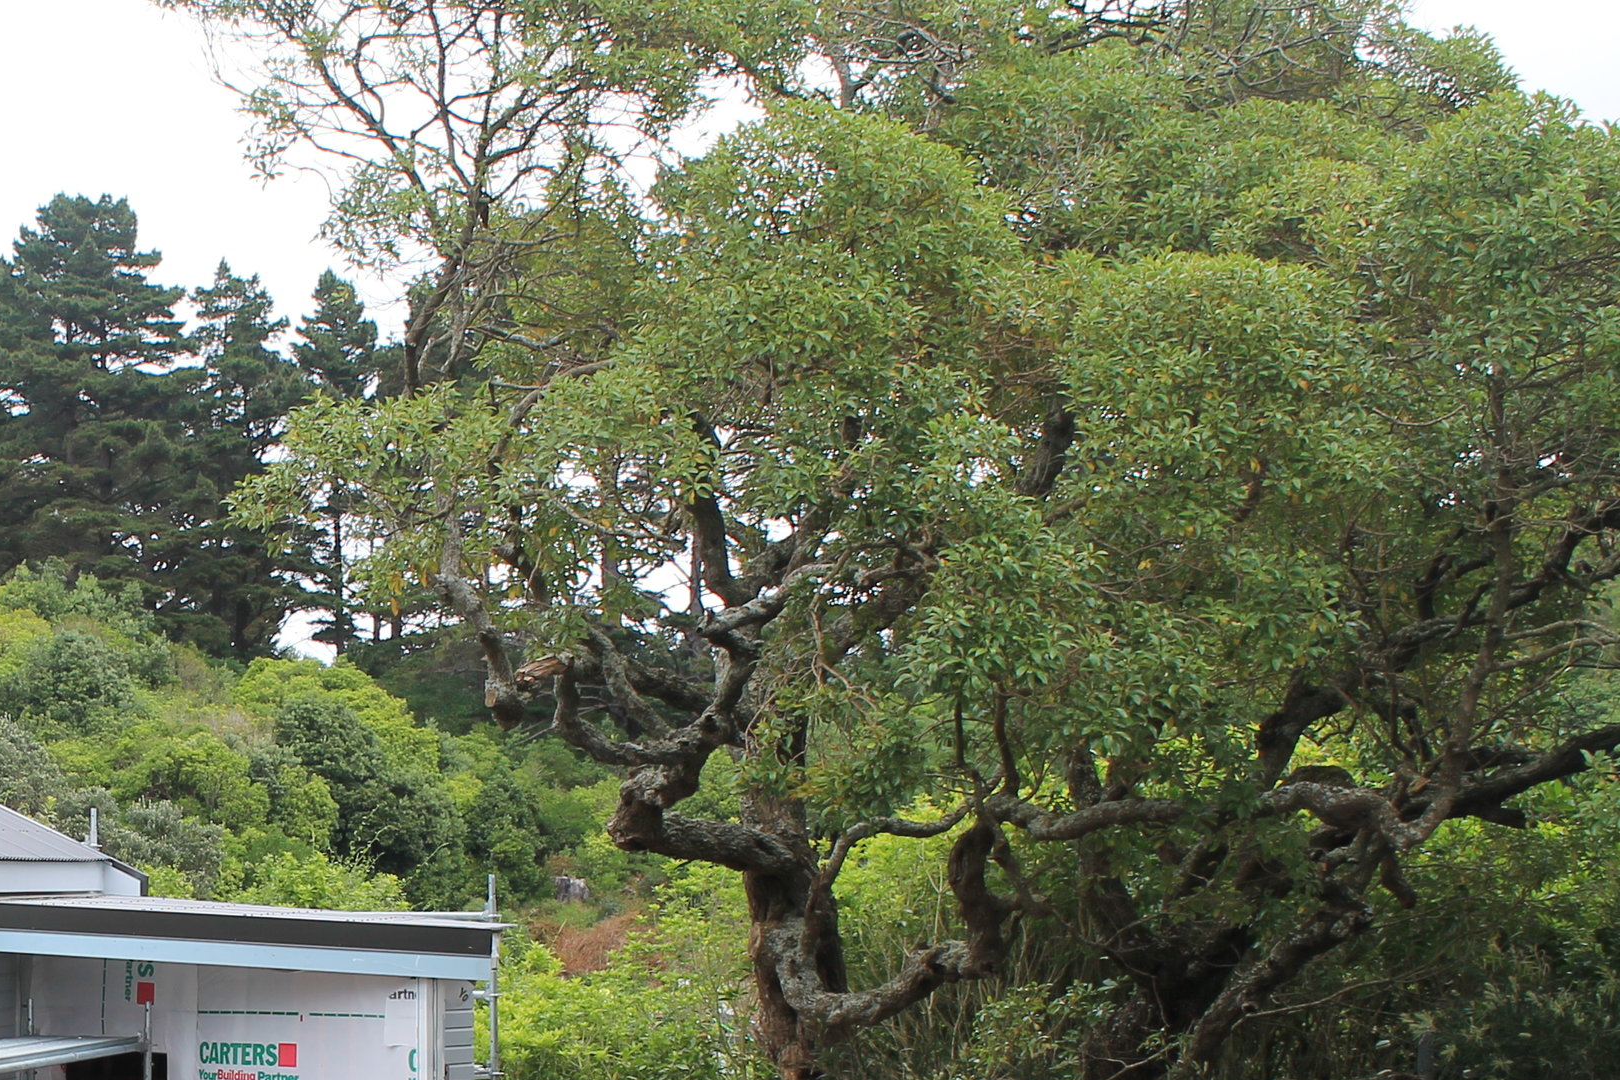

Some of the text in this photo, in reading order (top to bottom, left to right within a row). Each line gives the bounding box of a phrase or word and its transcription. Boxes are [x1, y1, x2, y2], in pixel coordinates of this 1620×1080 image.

[124, 960, 134, 1002] artner
[200, 1041, 278, 1066] CARTERS
[199, 1069, 218, 1080] Your
